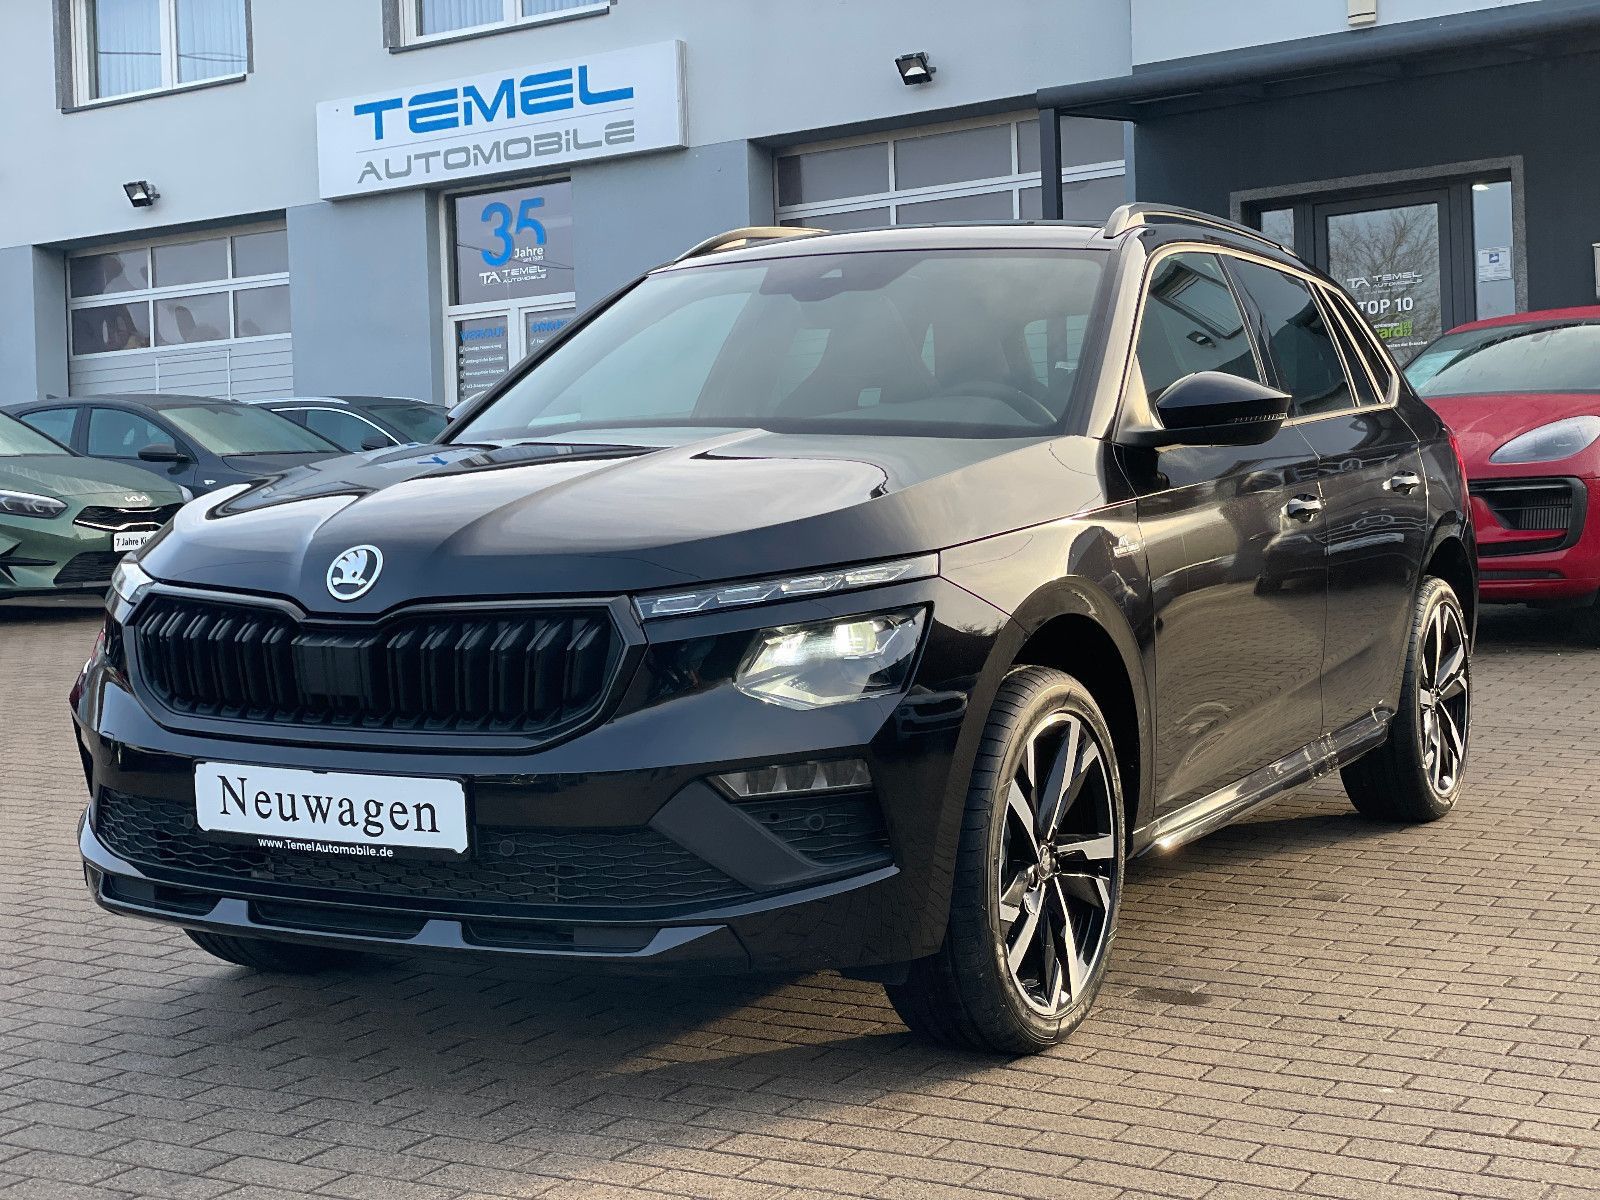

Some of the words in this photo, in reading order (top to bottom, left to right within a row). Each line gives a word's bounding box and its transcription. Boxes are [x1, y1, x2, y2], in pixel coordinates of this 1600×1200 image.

[354, 65, 634, 140] TEMEL
[480, 196, 547, 268] 35
[514, 246, 544, 259] Jahre
[479, 271, 502, 285] TA
[502, 265, 546, 277] TEMEL
[1372, 271, 1423, 282] TEMEL
[1346, 276, 1371, 289] TA
[1357, 299, 1391, 315] TOP
[1394, 296, 1414, 312] 10
[116, 538, 120, 546] 7
[122, 537, 139, 546] Jahre
[217, 774, 441, 838] Neuwagen
[257, 836, 394, 858] www.TemelAutomobile.de
